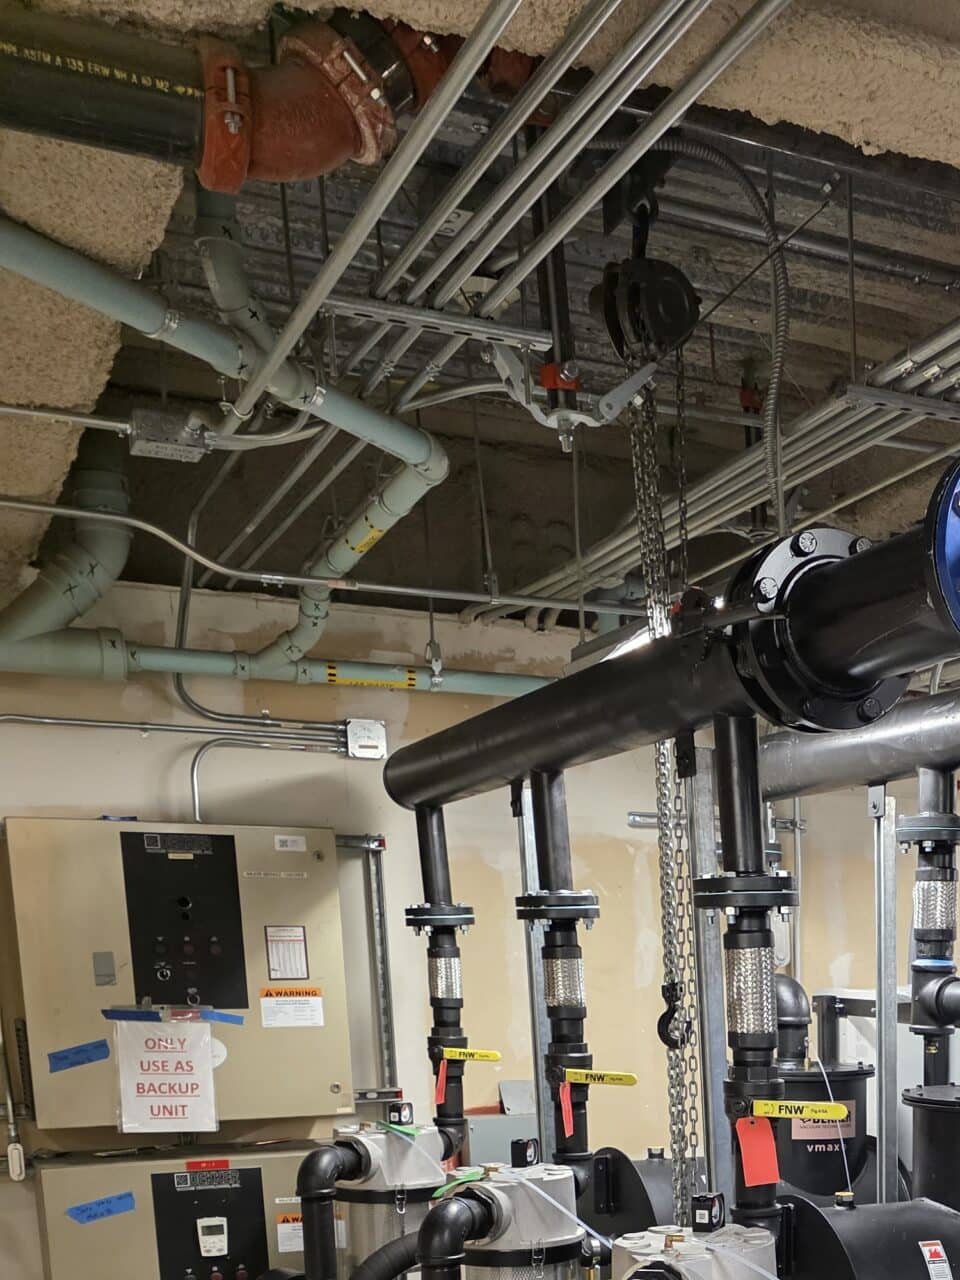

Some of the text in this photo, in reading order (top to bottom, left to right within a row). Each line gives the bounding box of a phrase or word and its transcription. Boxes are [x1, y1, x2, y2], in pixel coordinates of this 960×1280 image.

[274, 990, 318, 998] WARNING
[144, 1037, 188, 1051] ONLY
[140, 1060, 194, 1072] USE AS
[585, 1072, 605, 1082] FNW
[136, 1082, 200, 1095] BACKUP
[150, 1104, 188, 1117] UNIT
[778, 1104, 805, 1115] FNW
